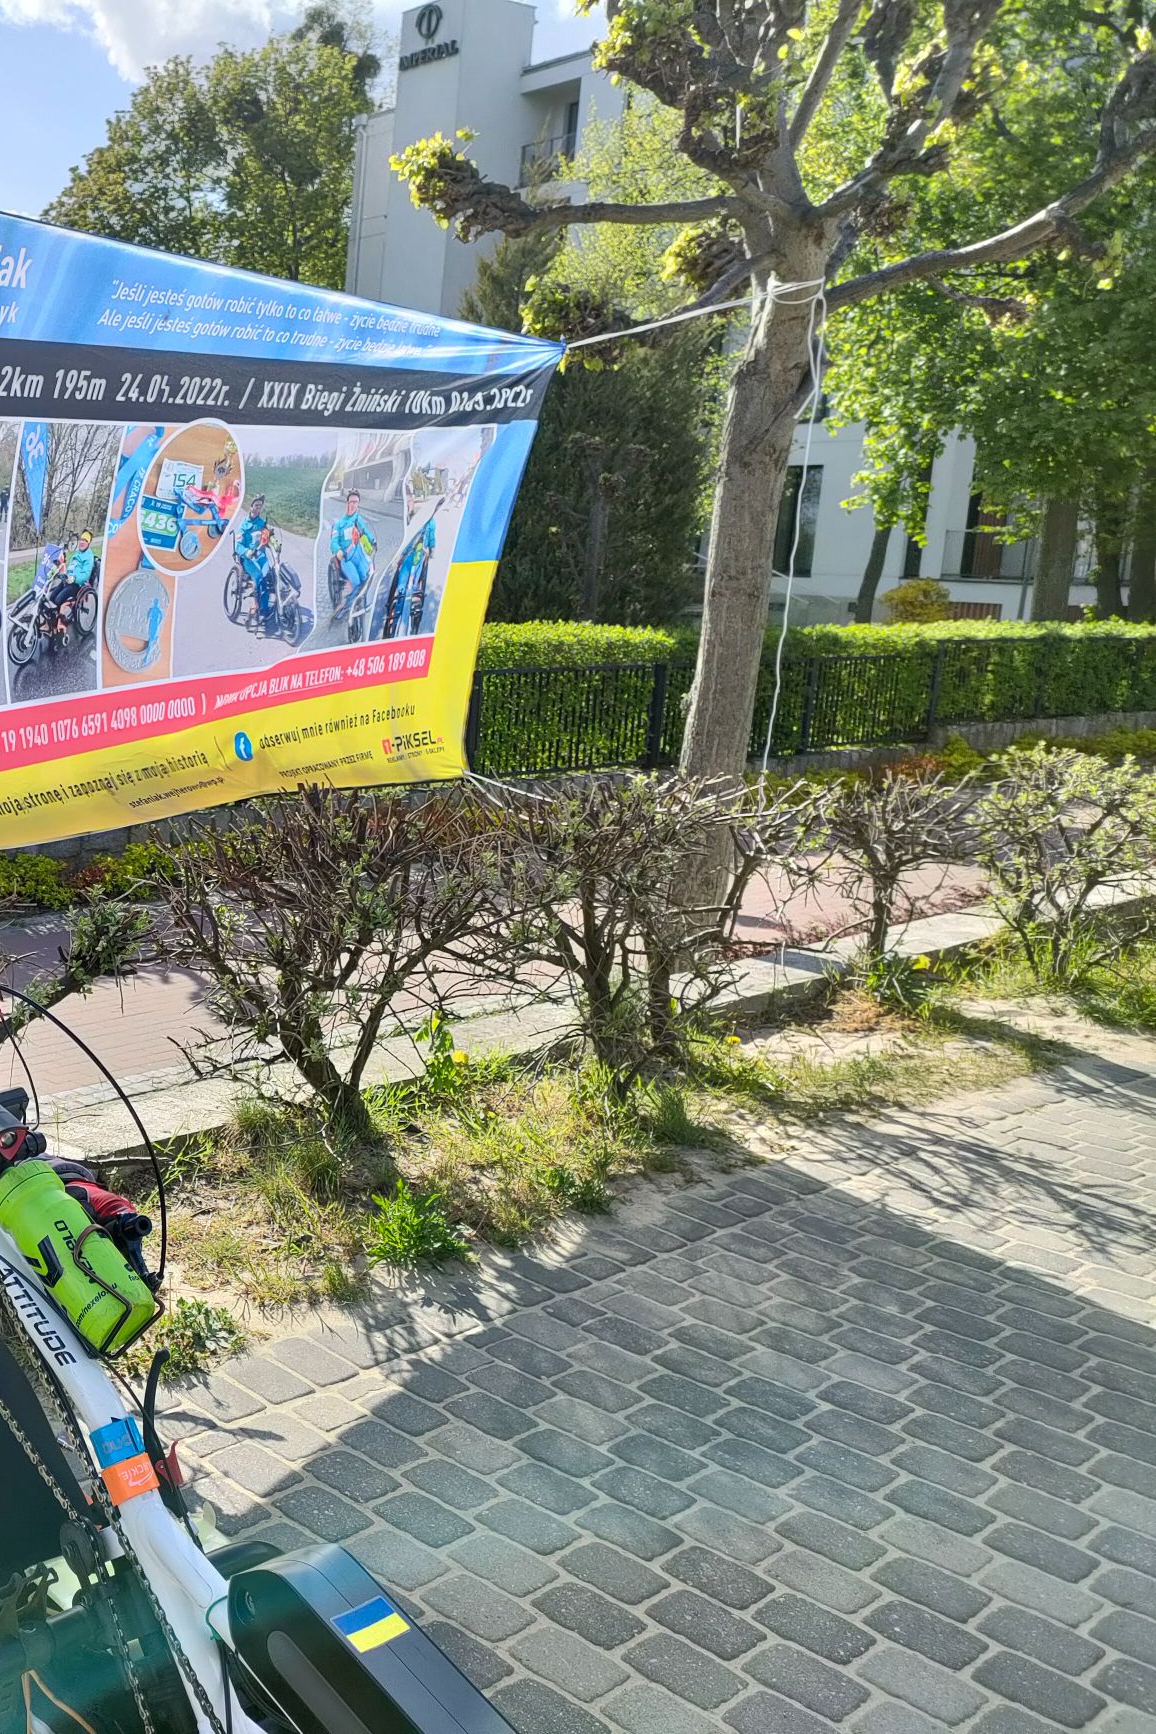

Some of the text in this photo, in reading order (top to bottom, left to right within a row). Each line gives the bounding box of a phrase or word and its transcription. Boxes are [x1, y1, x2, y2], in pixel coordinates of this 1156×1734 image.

[97, 309, 123, 327] Ale
[119, 311, 152, 332] jeśli
[149, 316, 194, 334] jesteś
[191, 320, 231, 339] gotów
[230, 324, 264, 341] robić
[262, 328, 275, 342] to
[275, 331, 290, 343] co
[290, 330, 328, 347] trudne
[143, 285, 187, 307] jesteś
[184, 292, 225, 312] gotów
[224, 297, 257, 315] robić
[256, 299, 284, 319] tylko
[285, 304, 297, 319] to
[298, 308, 310, 321] co
[349, 312, 376, 331] życie
[53, 369, 106, 400] 195m
[258, 381, 301, 409] XXIX
[301, 383, 347, 416] Biegi
[345, 382, 406, 412] Żniński
[1, 730, 16, 753] 19
[19, 723, 48, 749] 1940
[51, 717, 79, 742] 1076
[81, 712, 108, 736] 6591
[110, 706, 137, 731] 4098
[140, 701, 165, 724] 0000
[167, 696, 195, 719] 0000
[268, 675, 290, 694] BLIK
[290, 671, 303, 690] NA
[304, 664, 344, 687] TELEFON:
[346, 657, 365, 678] +48
[366, 655, 384, 676] 506
[388, 652, 404, 673] 189
[407, 649, 426, 669] 808
[301, 723, 323, 740] mnie
[325, 714, 358, 734] również
[360, 714, 370, 726] na
[372, 703, 416, 724] Facebooku
[26, 788, 64, 810] stronę
[60, 784, 69, 800] i
[117, 769, 136, 786] się
[166, 750, 210, 774] historią
